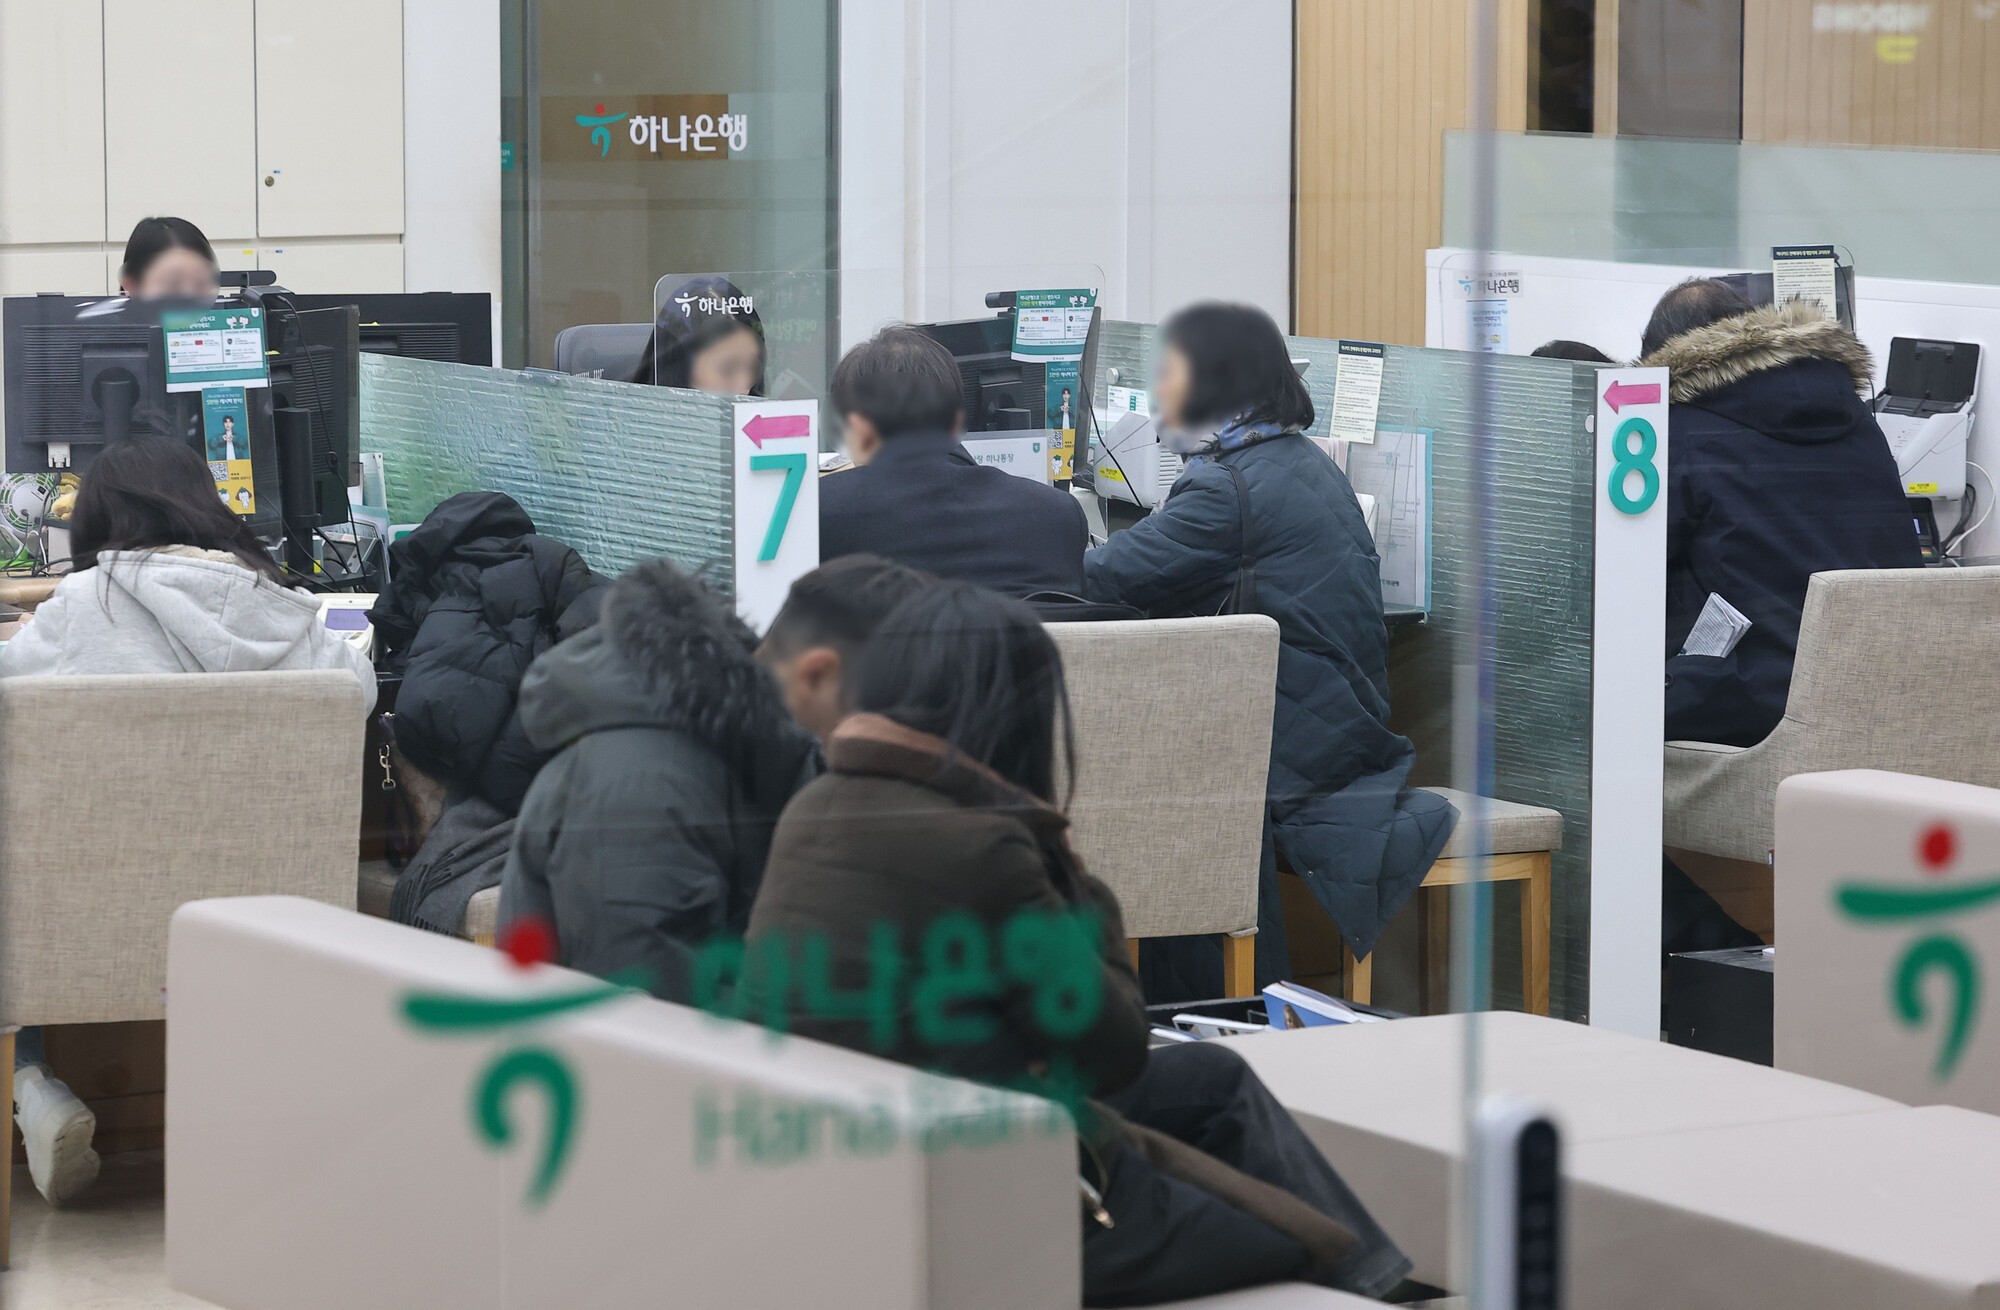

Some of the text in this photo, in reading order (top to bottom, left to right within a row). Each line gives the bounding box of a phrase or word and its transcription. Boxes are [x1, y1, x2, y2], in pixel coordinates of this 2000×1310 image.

[628, 113, 748, 153] 하나은행
[699, 295, 754, 316] 하나은행
[986, 453, 1014, 464] 하나통장
[1608, 417, 1660, 516] 8
[750, 453, 808, 562] 7
[694, 1084, 902, 1170] Hana
